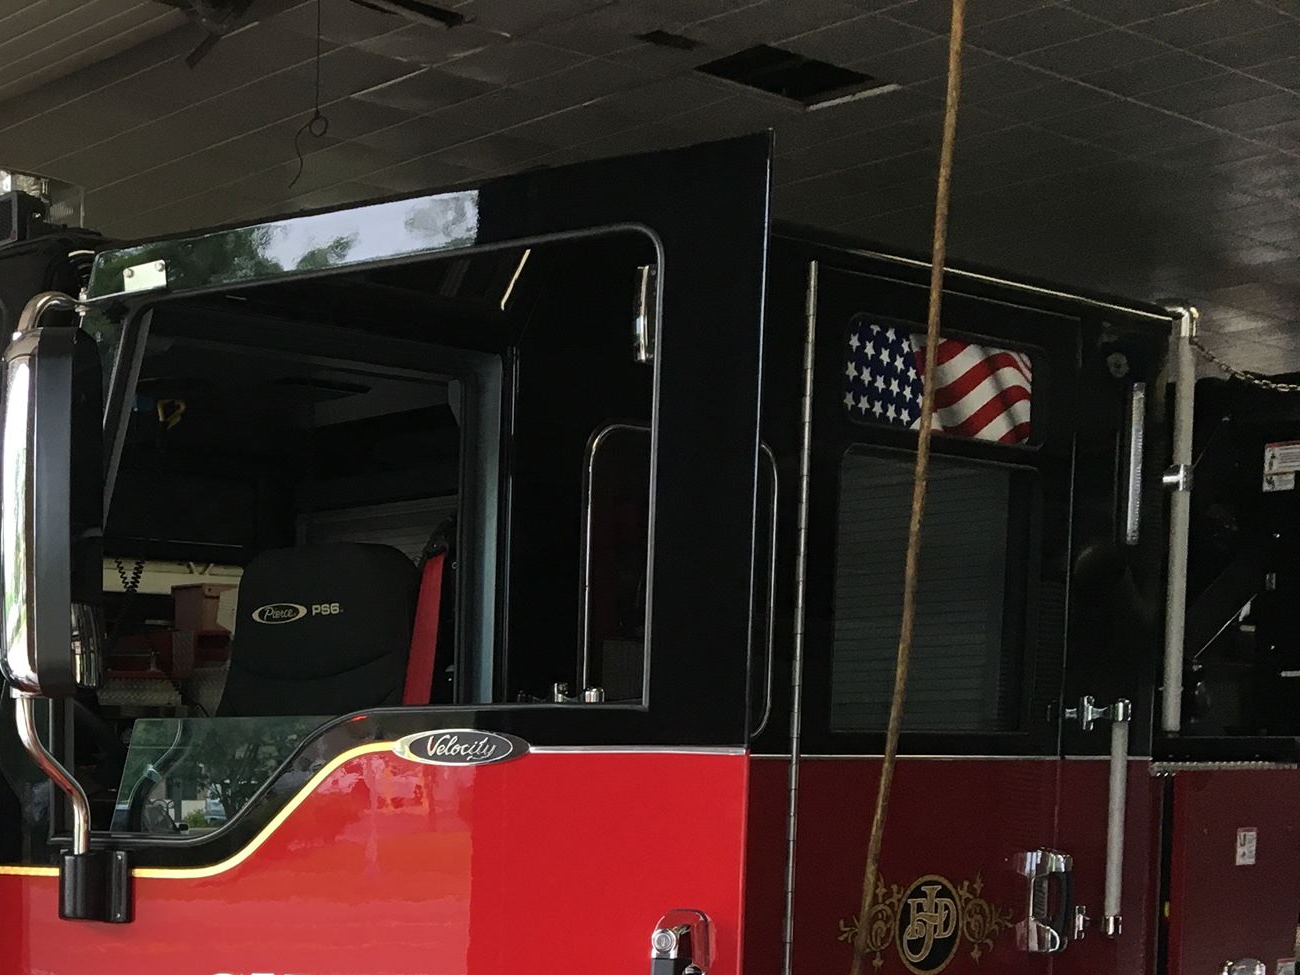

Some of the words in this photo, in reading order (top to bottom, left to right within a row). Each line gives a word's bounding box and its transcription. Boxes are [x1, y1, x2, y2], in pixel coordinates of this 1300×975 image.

[263, 606, 294, 620] Pierce
[312, 603, 340, 616] PS6
[427, 734, 496, 761] Velocity
